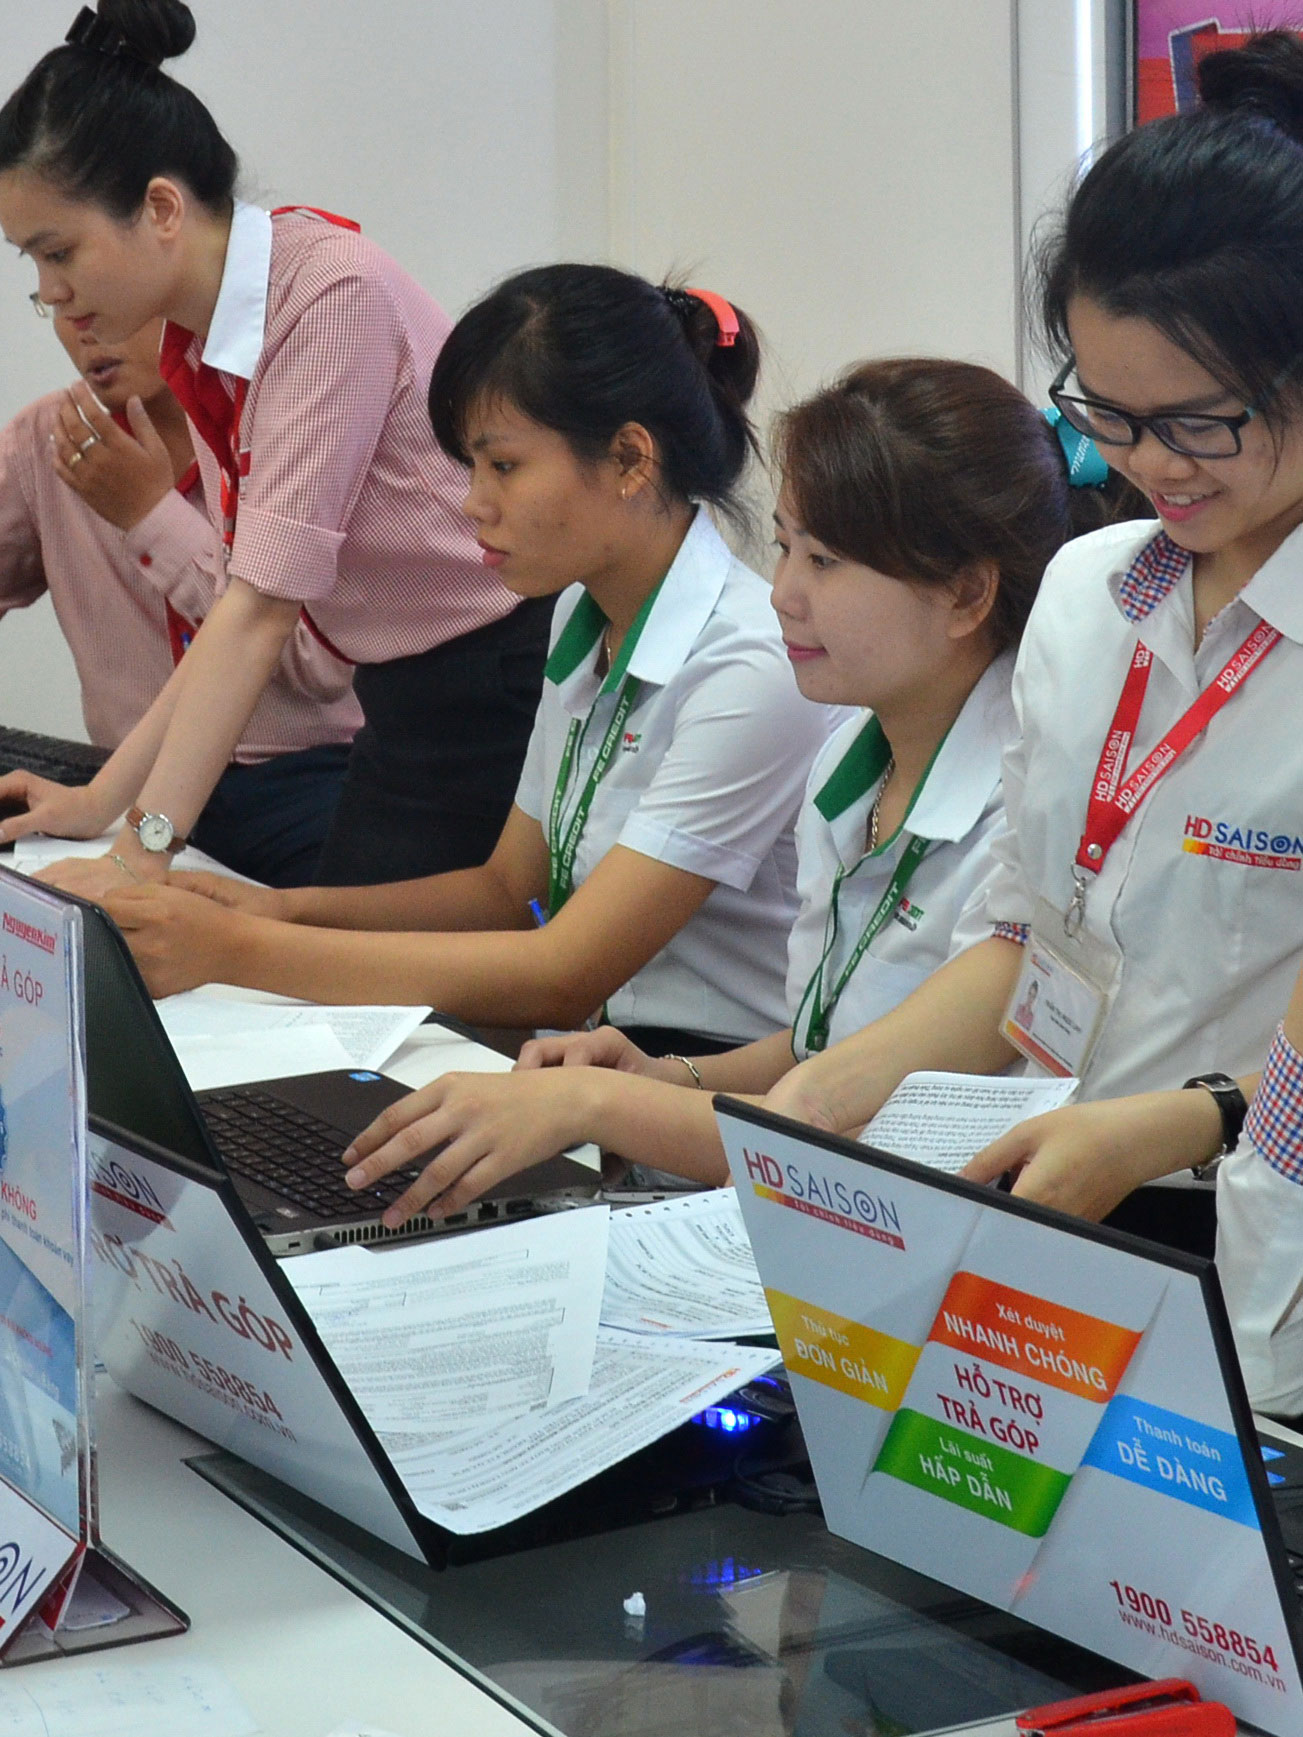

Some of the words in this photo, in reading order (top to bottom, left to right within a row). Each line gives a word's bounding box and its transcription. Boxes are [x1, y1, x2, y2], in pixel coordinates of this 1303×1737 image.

[1216, 668, 1235, 688] HD
[592, 760, 606, 783] FE
[602, 695, 632, 759] CREDIT
[1100, 730, 1123, 780] SAISON
[1095, 781, 1109, 802] HD
[1115, 788, 1133, 810] HD
[1129, 743, 1171, 790] SAISON
[563, 806, 586, 867] CREDIT
[1184, 814, 1213, 839] HD
[2, 911, 57, 952] NguyenKim
[859, 881, 900, 951] CREDIT
[13, 970, 44, 1007] GÓP
[1, 1179, 37, 1221] KHÔNG
[743, 1147, 784, 1189] HD
[786, 1164, 901, 1232] SAISON
[130, 1245, 218, 1324] TRẢ
[211, 1290, 293, 1362] GÓP
[996, 1303, 1022, 1326] Xét
[1024, 1314, 1066, 1343] duyệt
[794, 1337, 837, 1373] ĐƠN
[840, 1357, 889, 1394] GIẢN
[943, 1310, 1020, 1358] NHANH
[1024, 1342, 1108, 1392] CHÓNG
[936, 1393, 987, 1435] TRẢ
[989, 1416, 1039, 1454] GÓP
[954, 1363, 991, 1398] HỖ
[992, 1378, 1044, 1427] TRỢ
[939, 1436, 961, 1458] Lãi
[963, 1450, 994, 1472] suất
[1133, 1415, 1183, 1448] Thanh
[1185, 1436, 1221, 1462] toán
[919, 1453, 961, 1487] HẤP
[966, 1471, 1012, 1512] DẪN
[1117, 1437, 1151, 1472] DỄ
[1156, 1456, 1227, 1502] DÀNG
[1109, 1580, 1172, 1626] 1900
[1181, 1609, 1279, 1672] 558854
[1118, 1609, 1287, 1692] www.hdsaison.com.vn
